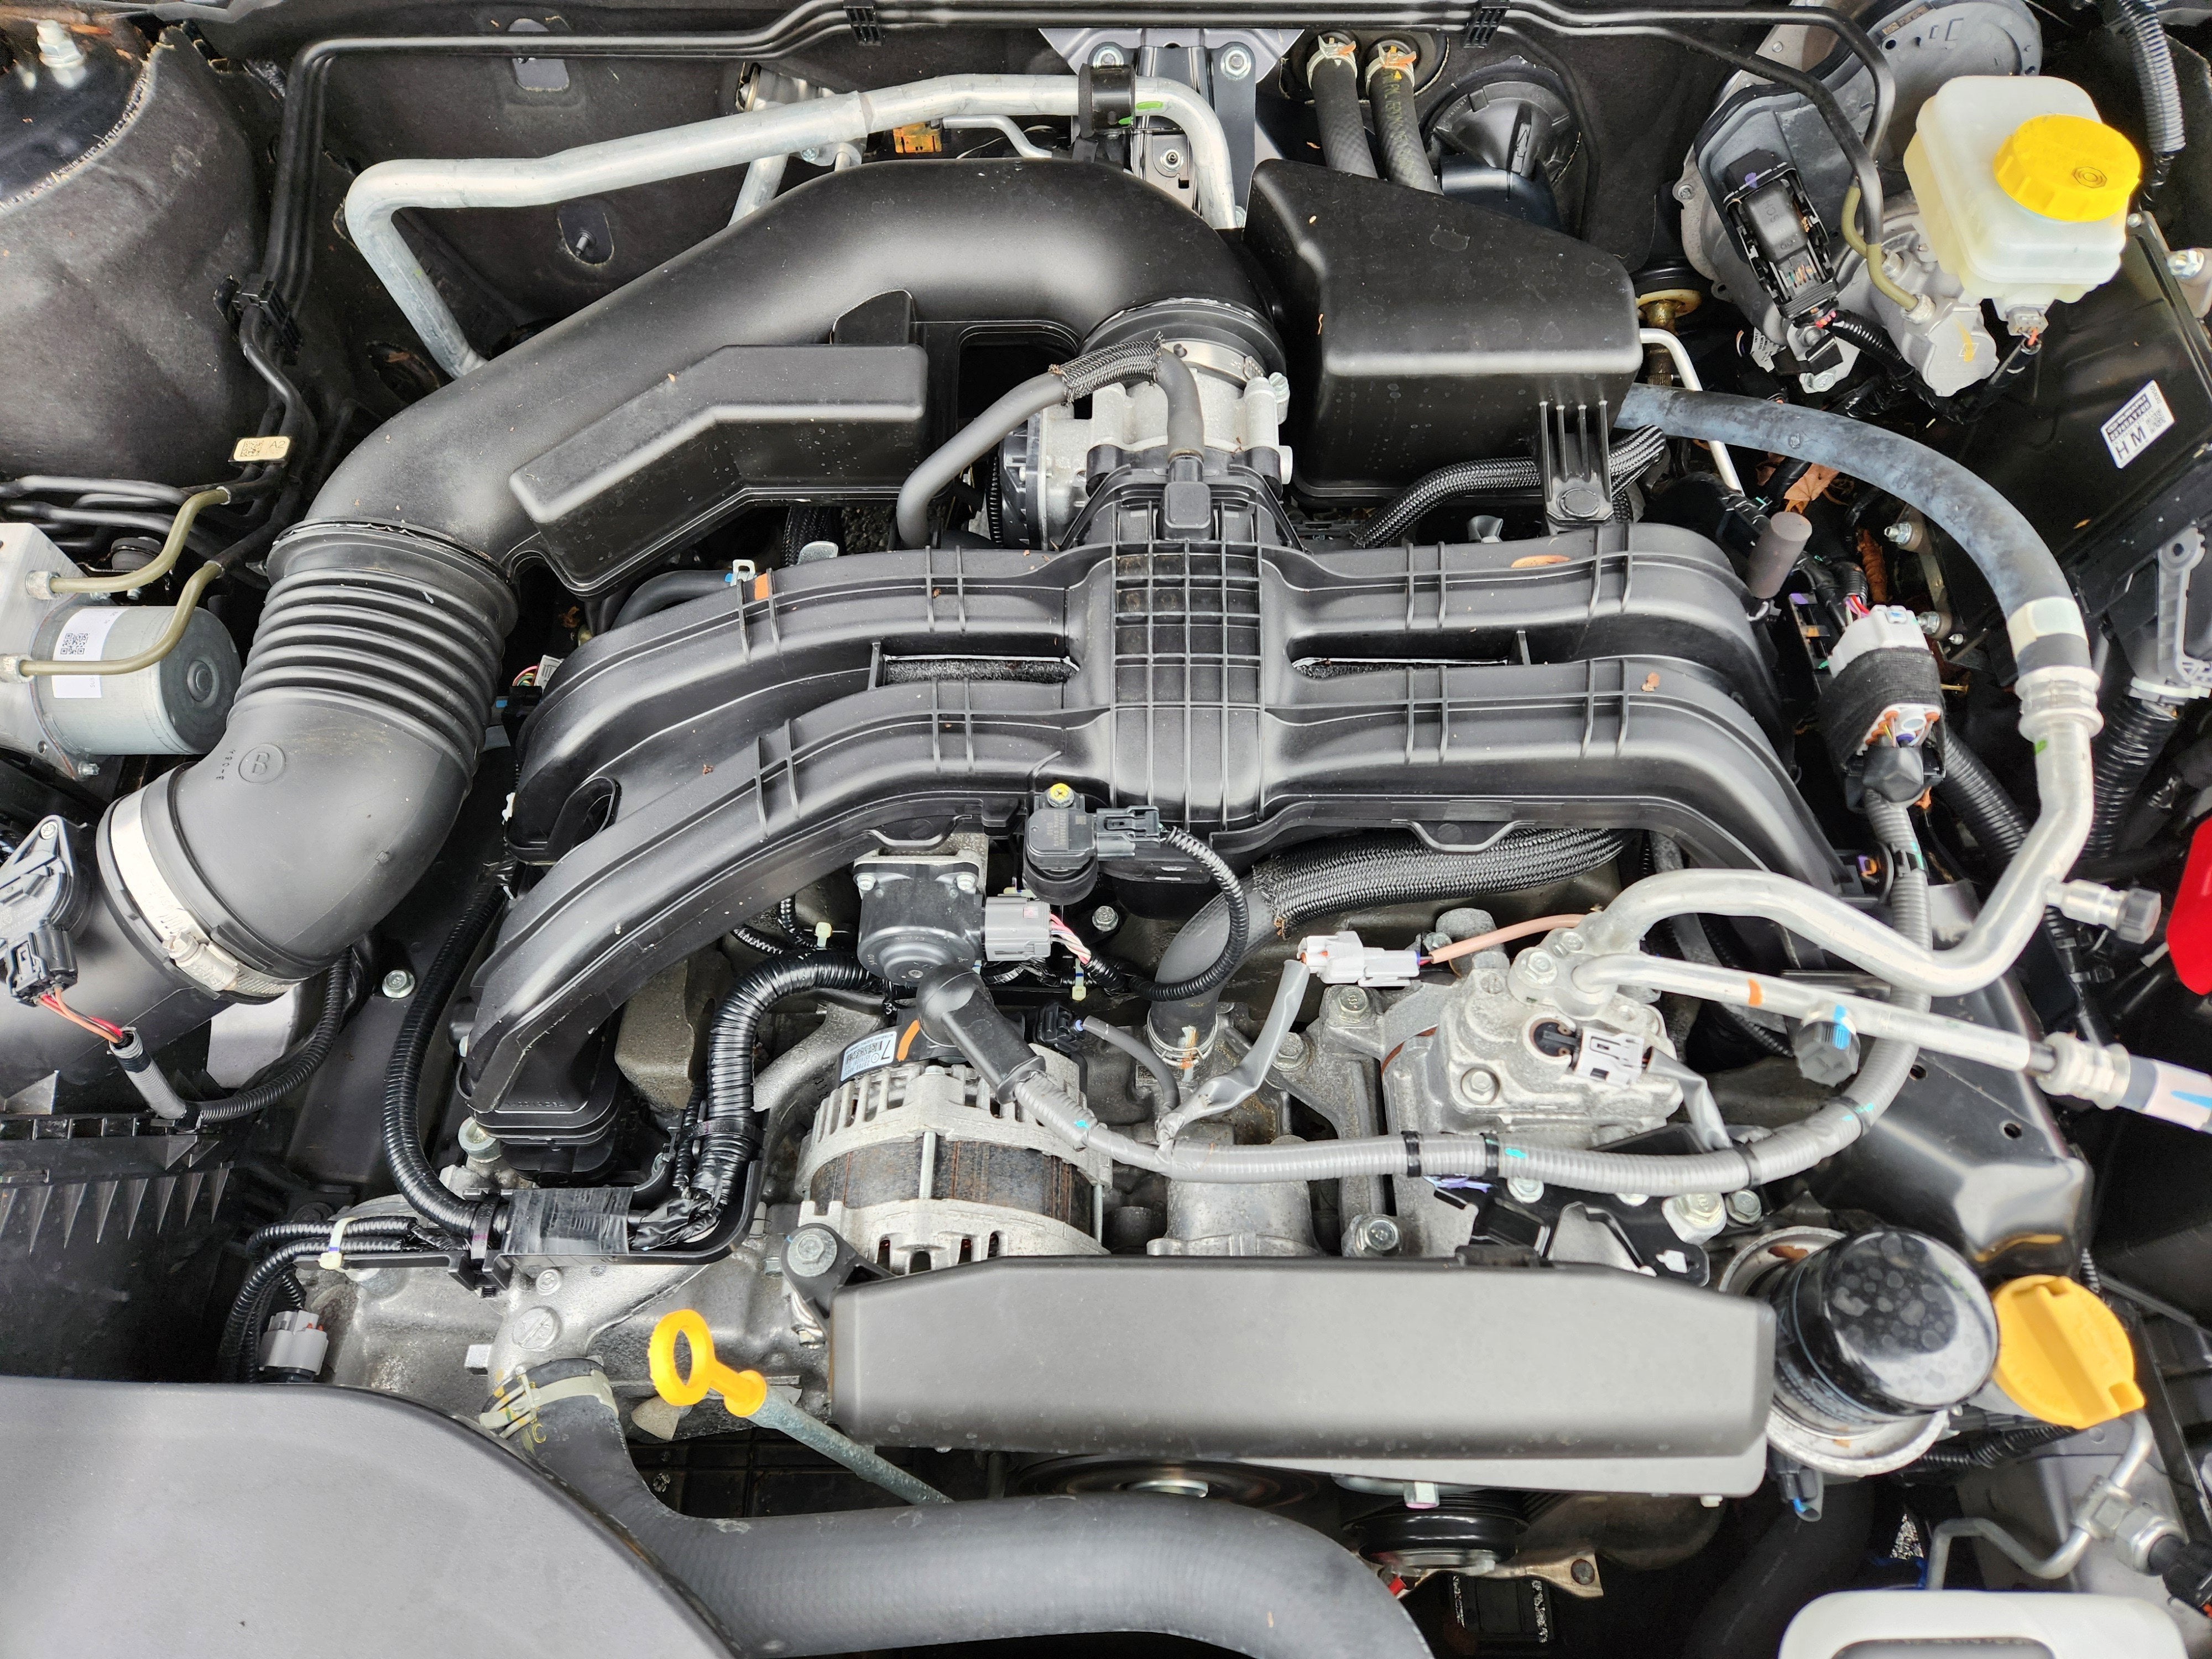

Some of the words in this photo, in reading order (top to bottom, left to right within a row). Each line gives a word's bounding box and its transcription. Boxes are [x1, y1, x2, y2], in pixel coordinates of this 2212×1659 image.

[2150, 385, 2162, 404] DENSO
[2119, 395, 2147, 425] SUBARU
[269, 440, 285, 448] A2
[2116, 441, 2130, 460] H
[2131, 426, 2146, 447] M
[252, 752, 270, 775] B
[881, 1040, 891, 1060] 7
